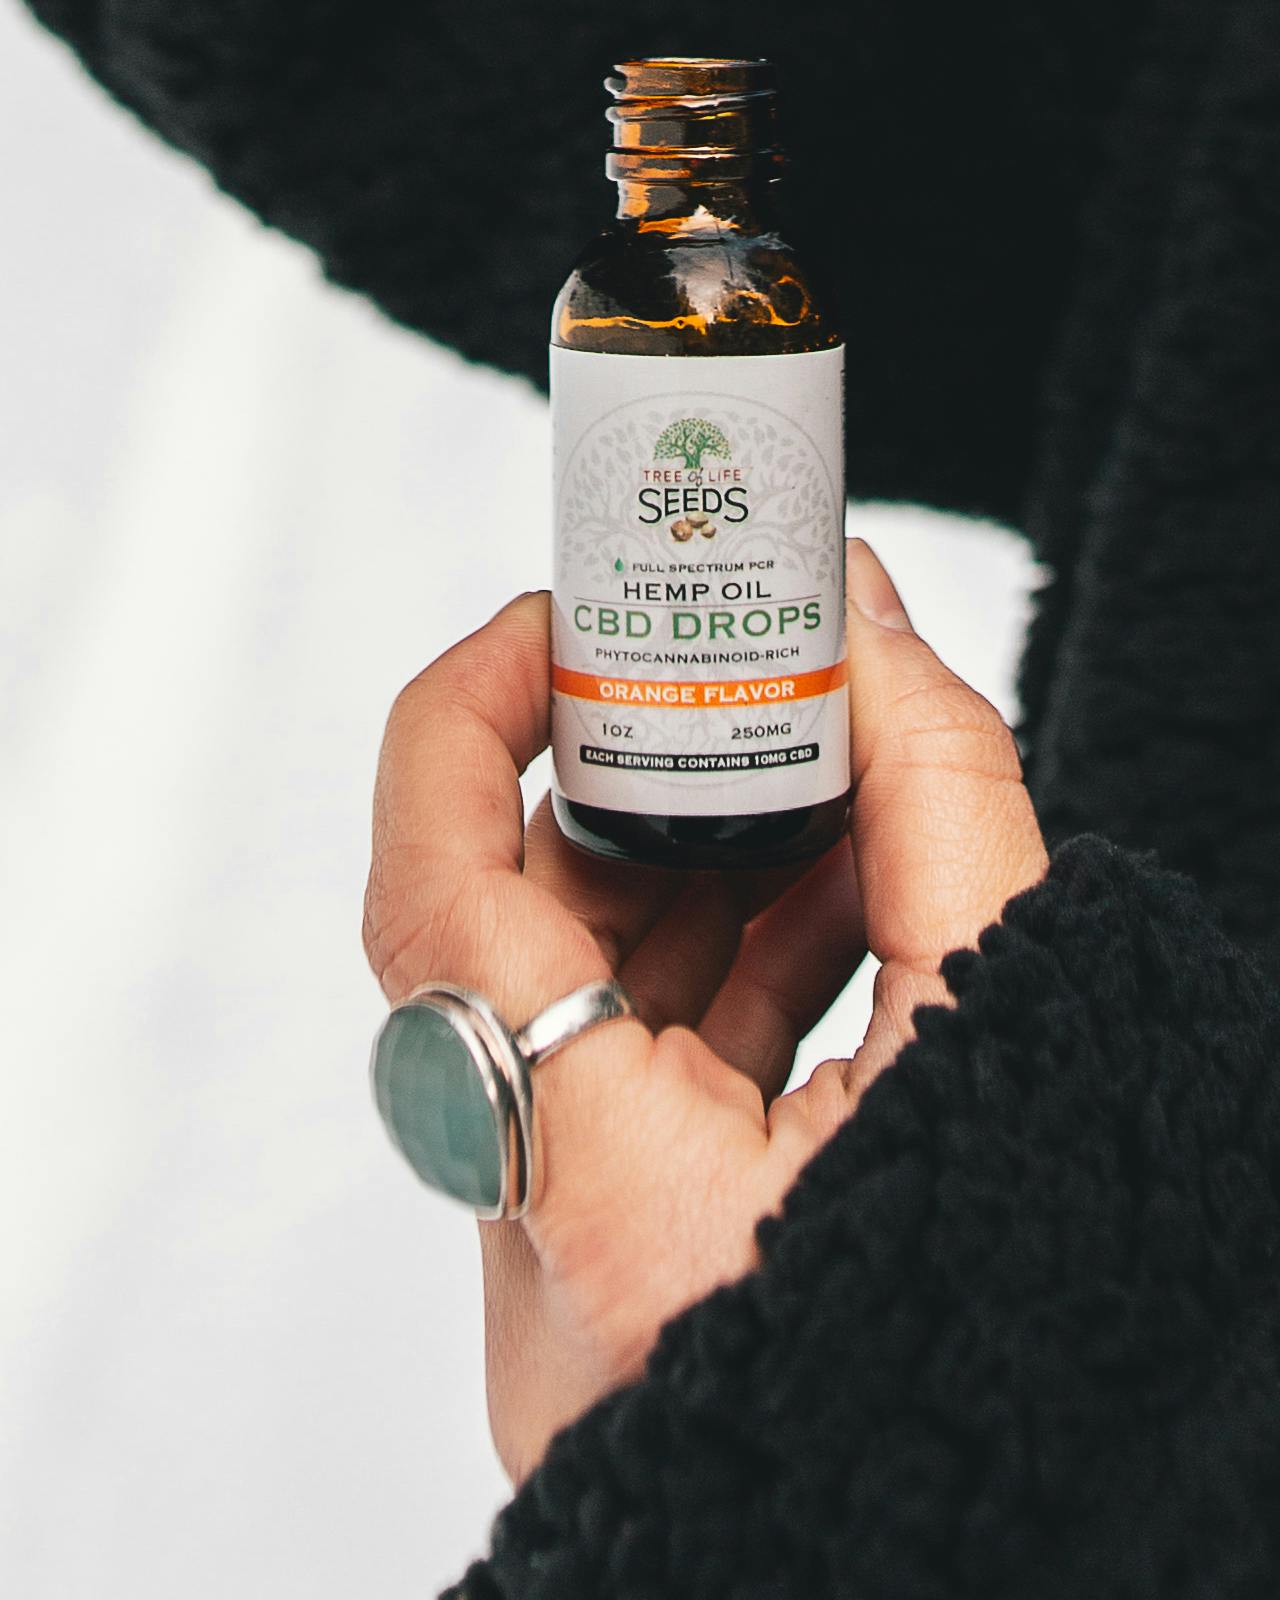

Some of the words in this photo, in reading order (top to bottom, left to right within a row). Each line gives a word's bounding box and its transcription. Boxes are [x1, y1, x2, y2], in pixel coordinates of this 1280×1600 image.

[643, 470, 682, 483] TREE
[687, 468, 704, 487] of
[708, 469, 742, 482] LIFE
[638, 487, 749, 524] SEEDS
[632, 563, 665, 573] FULL
[669, 561, 745, 573] SPECTRUM
[624, 581, 710, 601] HEMP
[721, 581, 772, 600] OIL
[574, 605, 652, 638] CBD
[672, 602, 822, 641] DROPS
[595, 646, 800, 664] PHYTOCANNABINOID-RICH
[599, 684, 696, 703] ORANGE
[704, 680, 795, 703] FLAVOR
[602, 723, 634, 739] 1OZ
[730, 722, 792, 740] 250MG
[585, 751, 614, 764] EACH
[617, 753, 674, 768] SERVING
[678, 754, 750, 768] CONTAINS
[754, 752, 787, 767] 10MG
[789, 747, 813, 762] CBD
